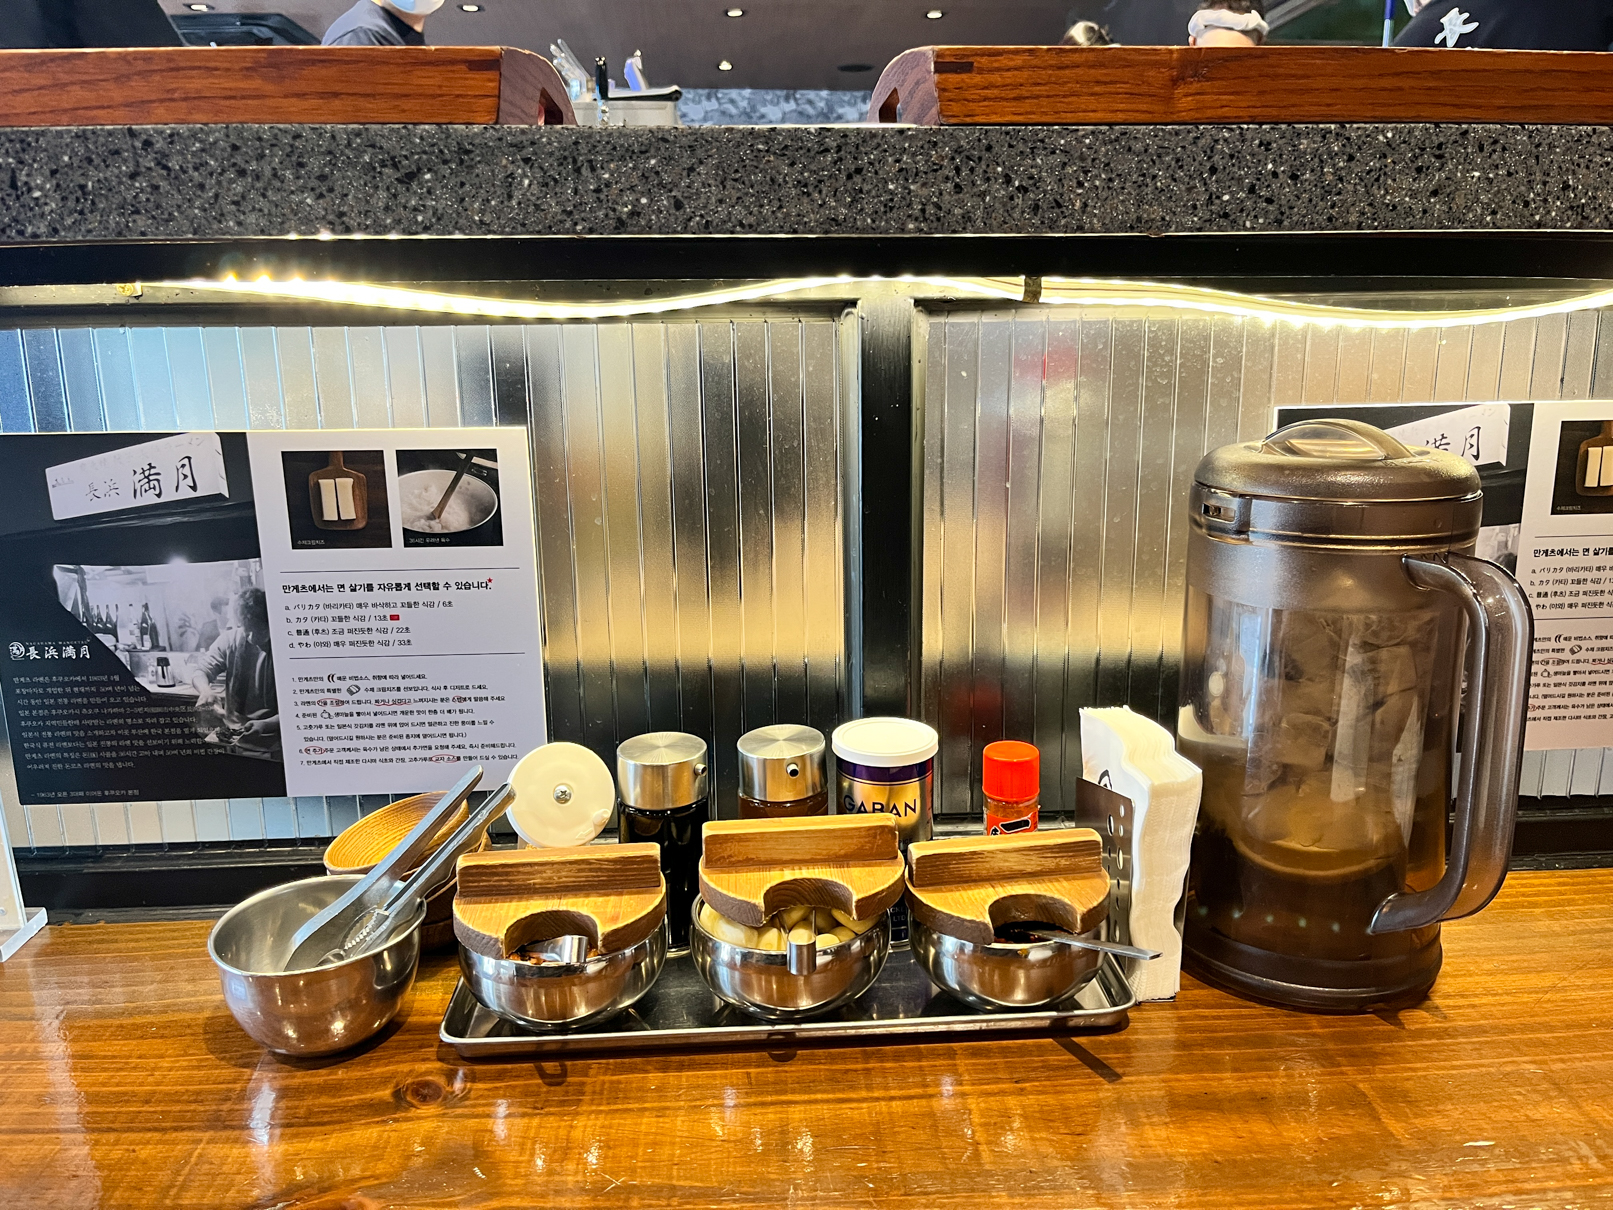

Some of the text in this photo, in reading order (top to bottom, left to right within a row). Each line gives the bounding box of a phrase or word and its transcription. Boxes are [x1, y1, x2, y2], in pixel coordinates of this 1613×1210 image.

[1582, 548, 1590, 556] 면
[337, 584, 346, 593] 면
[377, 583, 412, 592] 자유롭게
[415, 583, 440, 592] 선택할
[443, 583, 452, 591] 수
[454, 582, 492, 591] 있습니다.
[844, 794, 916, 818] GABAN
